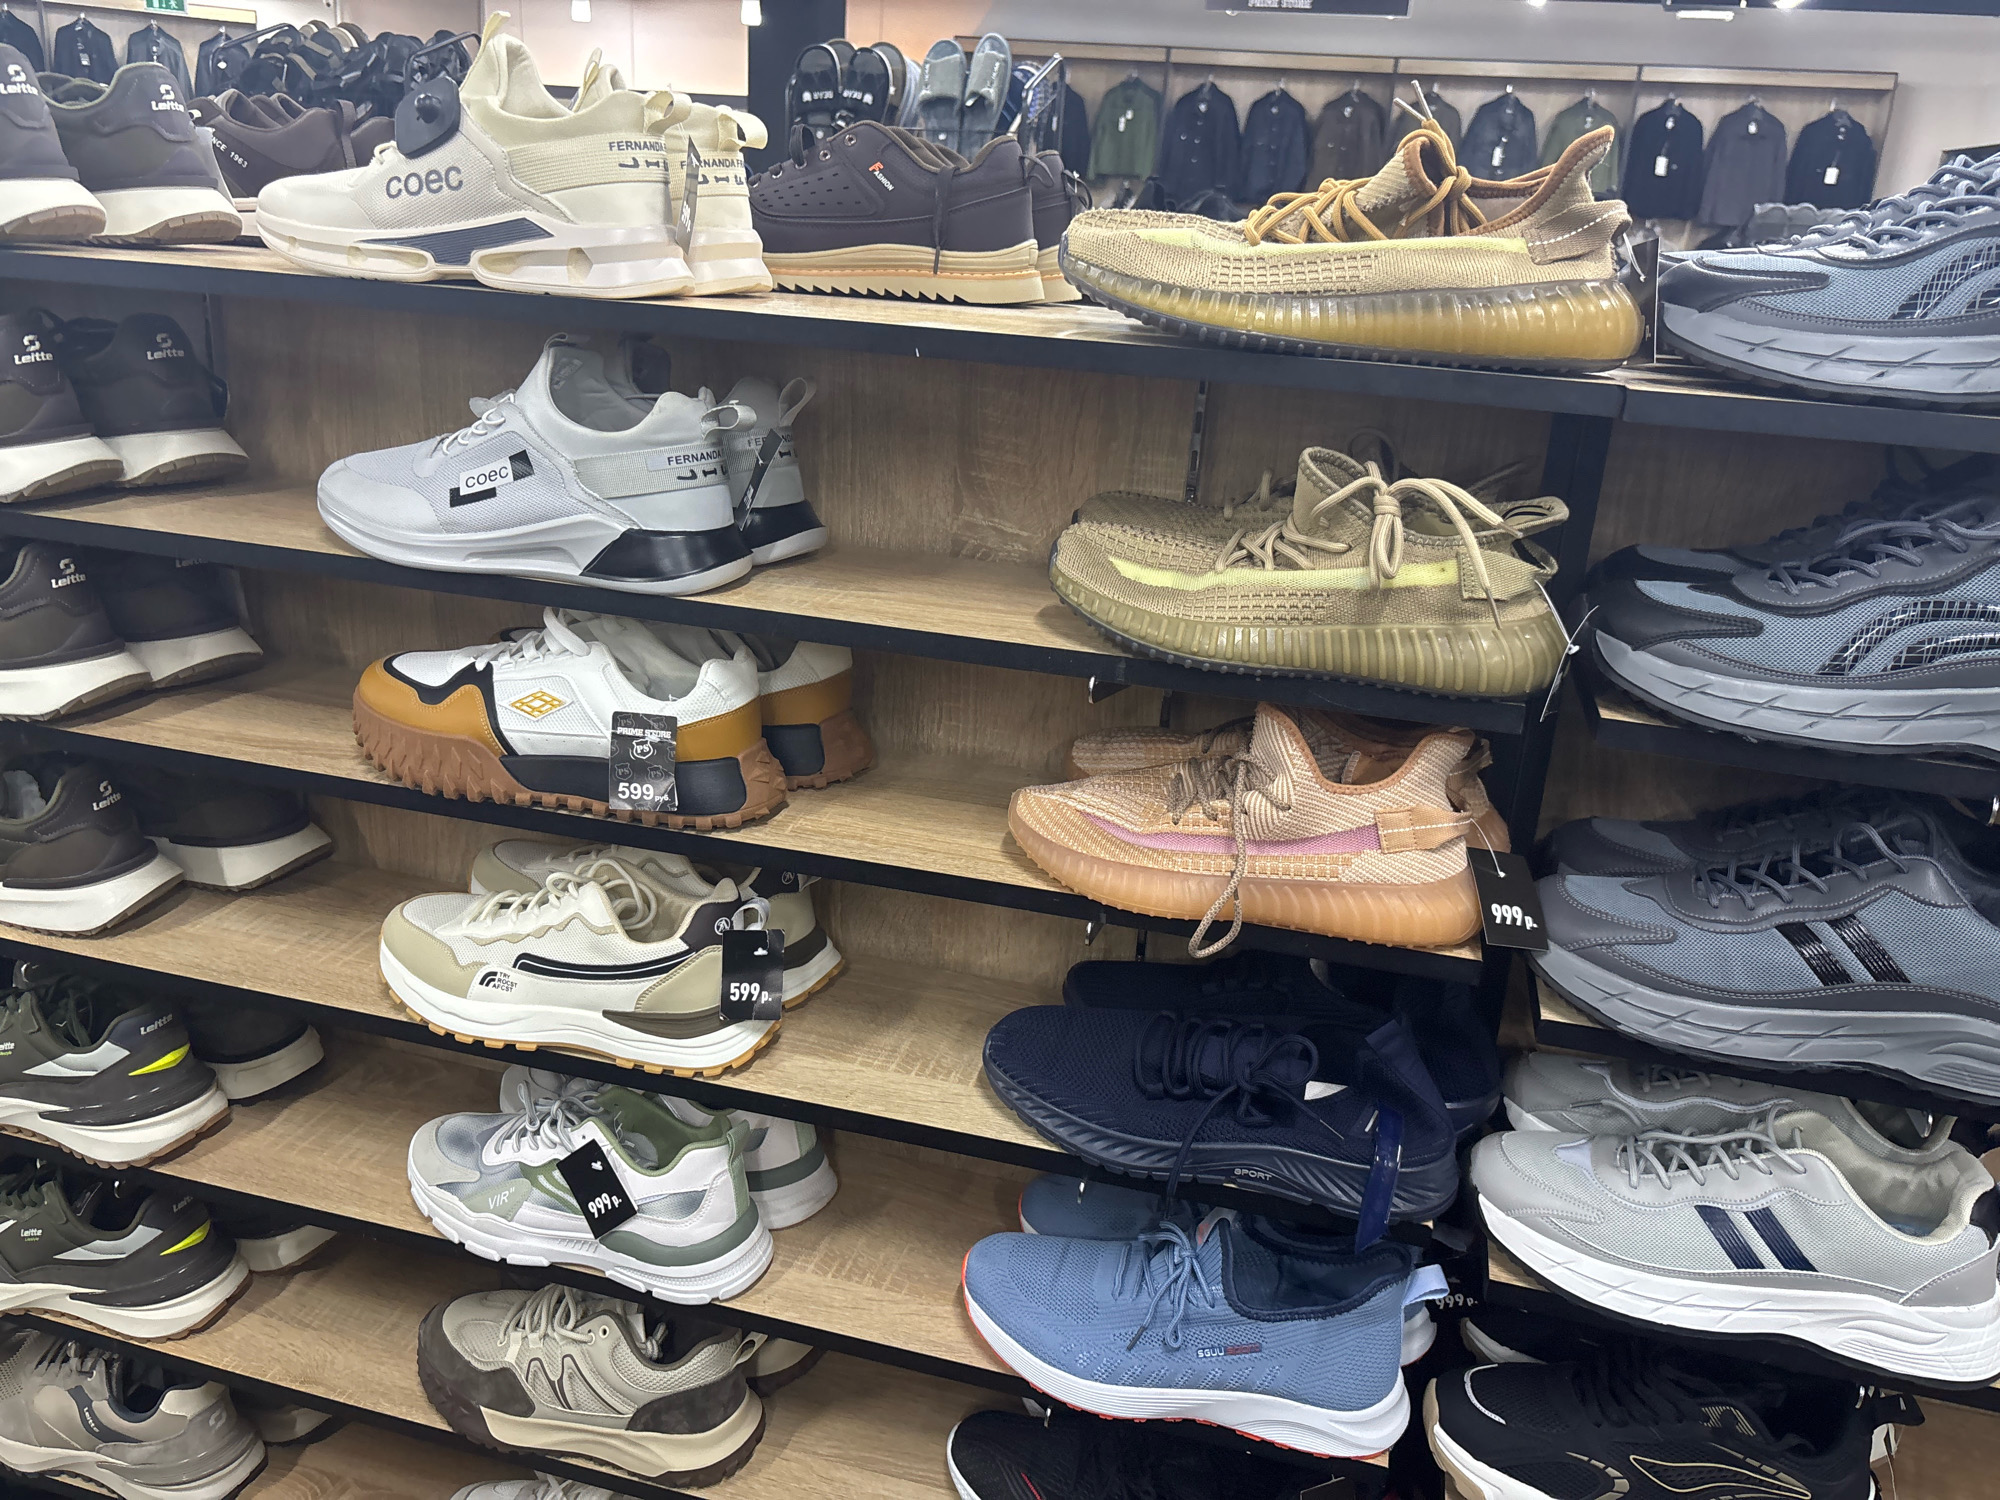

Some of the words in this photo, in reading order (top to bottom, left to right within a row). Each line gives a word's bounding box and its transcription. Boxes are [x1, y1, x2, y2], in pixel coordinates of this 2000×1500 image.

[212, 136, 228, 152] NCE
[230, 151, 248, 168] 1963
[386, 166, 464, 200] coec
[868, 161, 895, 191] FASHION
[14, 351, 53, 365] Leitte
[465, 466, 509, 489] coec
[617, 727, 644, 736] PRIME
[645, 729, 672, 739] STORE
[636, 744, 650, 754] PS
[617, 782, 654, 800] 599
[654, 794, 672, 803] руб.
[1491, 903, 1523, 927] 999
[499, 971, 511, 980] TRY
[729, 982, 760, 1001] 599
[1233, 1168, 1272, 1181] SPORT
[588, 1192, 612, 1219] 999
[1435, 1293, 1464, 1310] 999
[1197, 1347, 1225, 1358] SGUU
